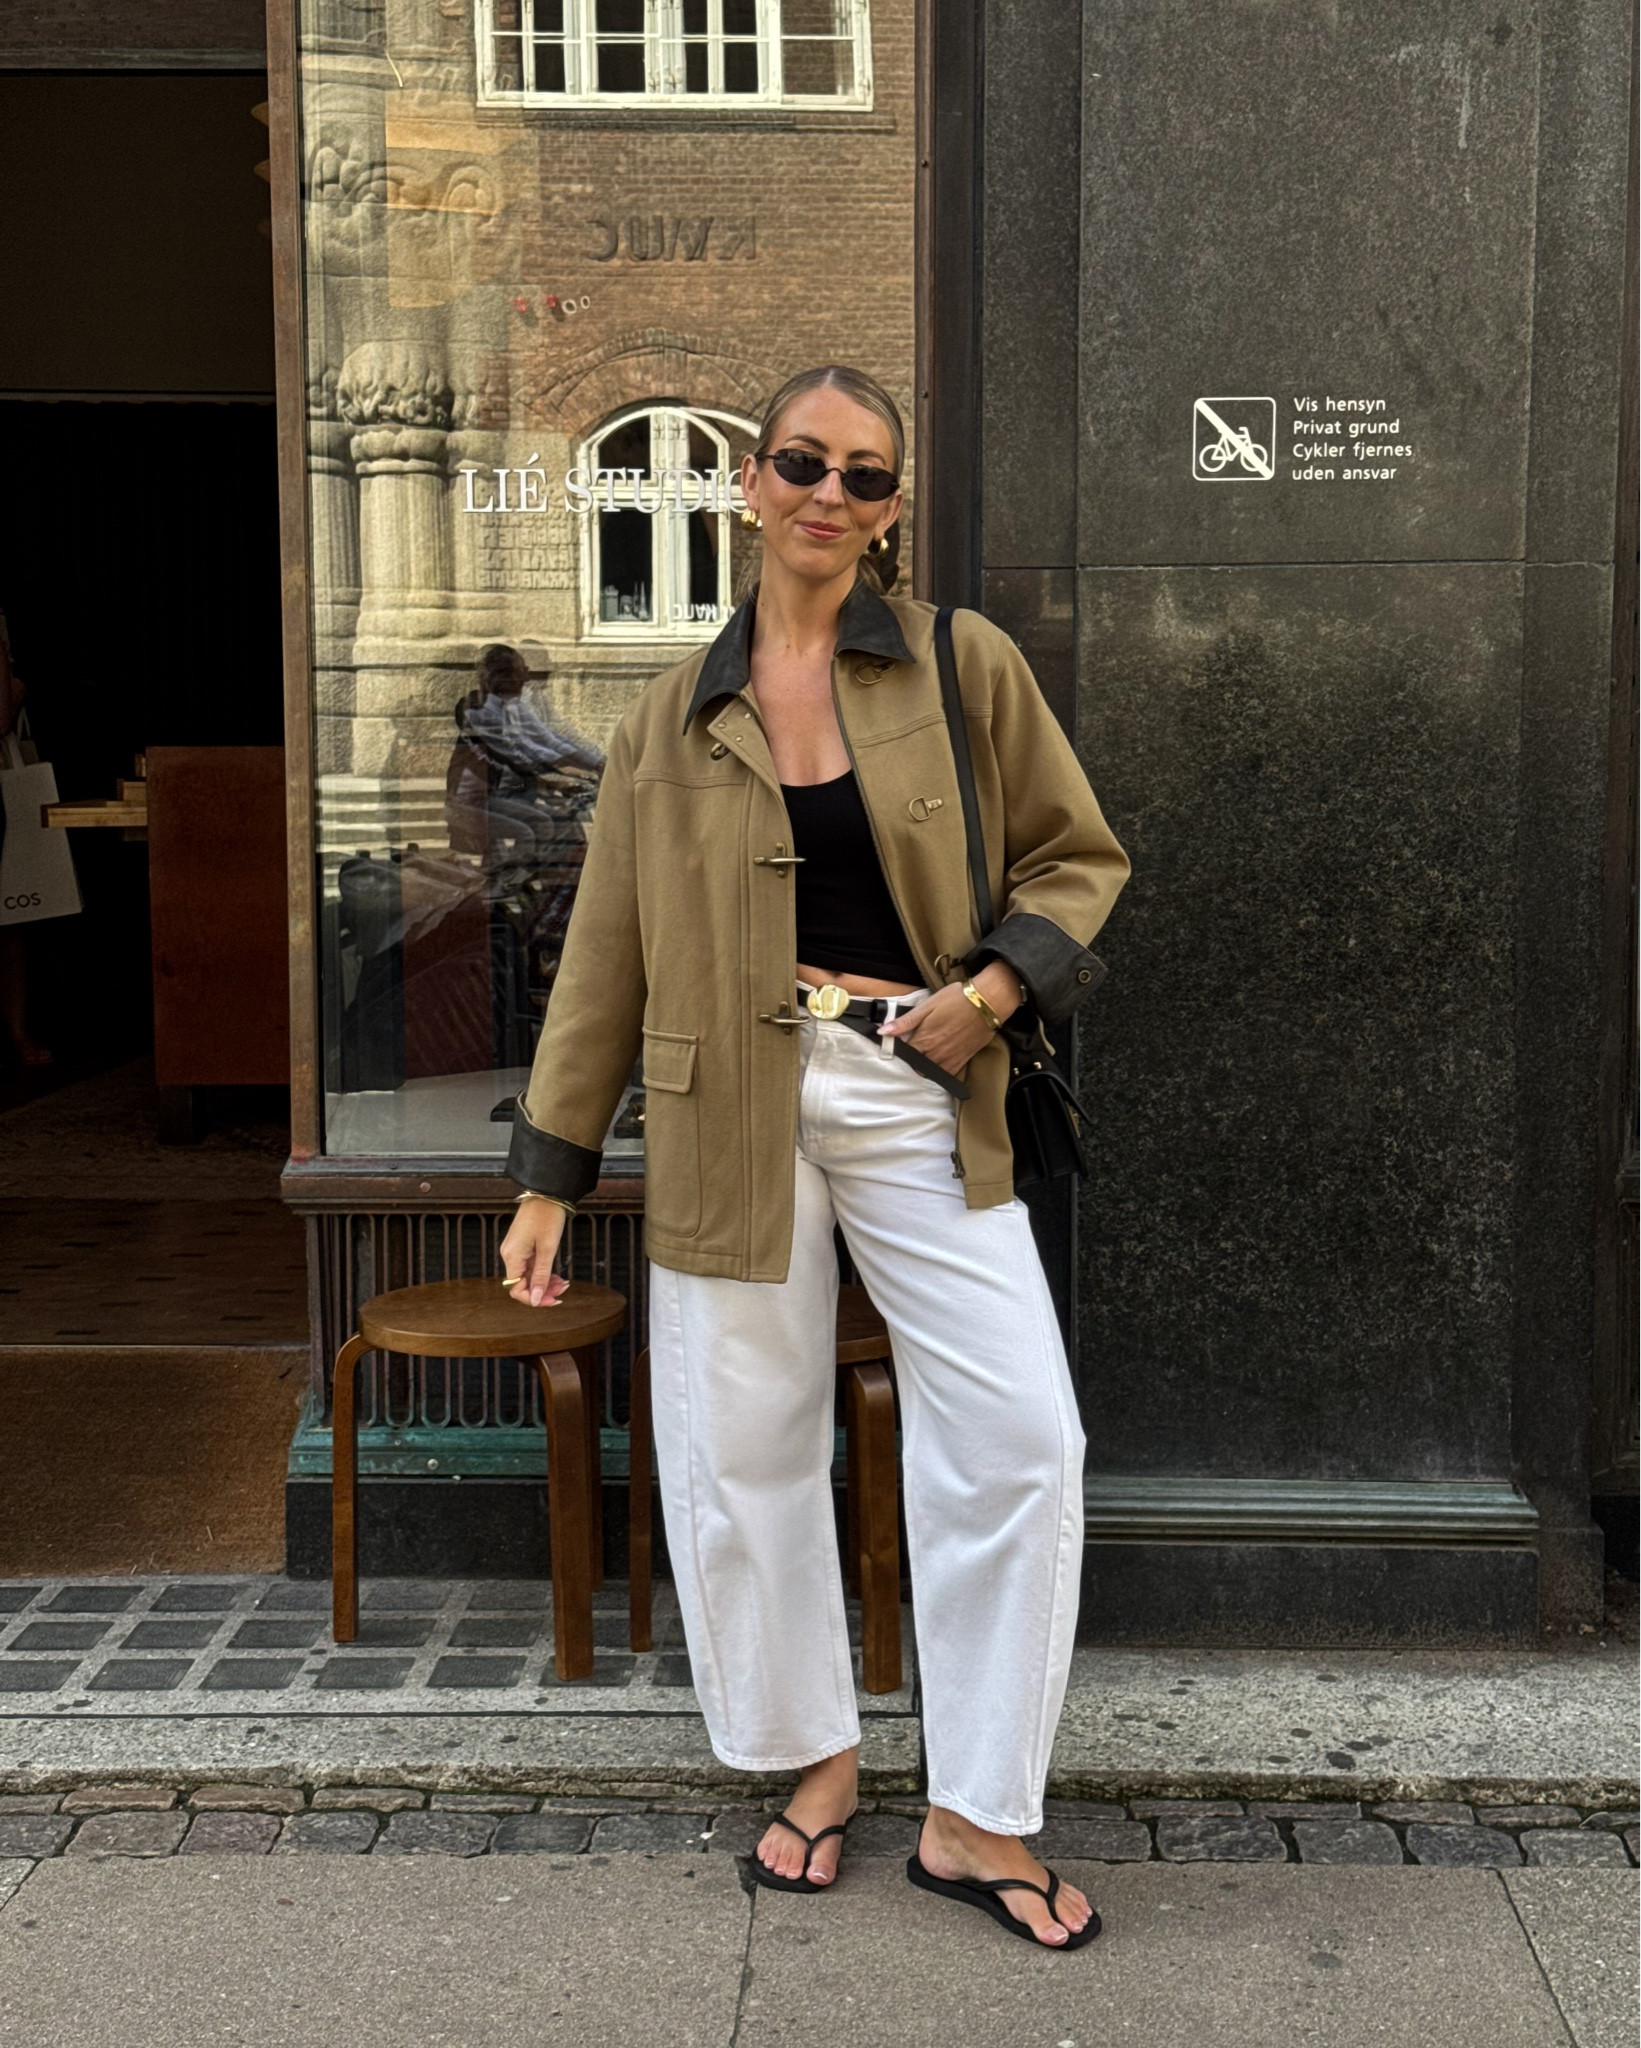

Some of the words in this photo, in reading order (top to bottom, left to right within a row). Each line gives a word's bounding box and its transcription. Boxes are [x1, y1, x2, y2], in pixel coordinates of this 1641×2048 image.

[1293, 396, 1319, 412] Vis
[1325, 396, 1386, 415] hensyn
[1293, 419, 1342, 435] Privat
[1348, 418, 1400, 438] grund
[1292, 442, 1346, 461] Cykler
[1352, 442, 1413, 461] fjernes
[459, 451, 549, 513] LIÉ
[1291, 465, 1335, 481] uden
[1342, 467, 1398, 481] ansvar
[4, 892, 41, 910] COS
